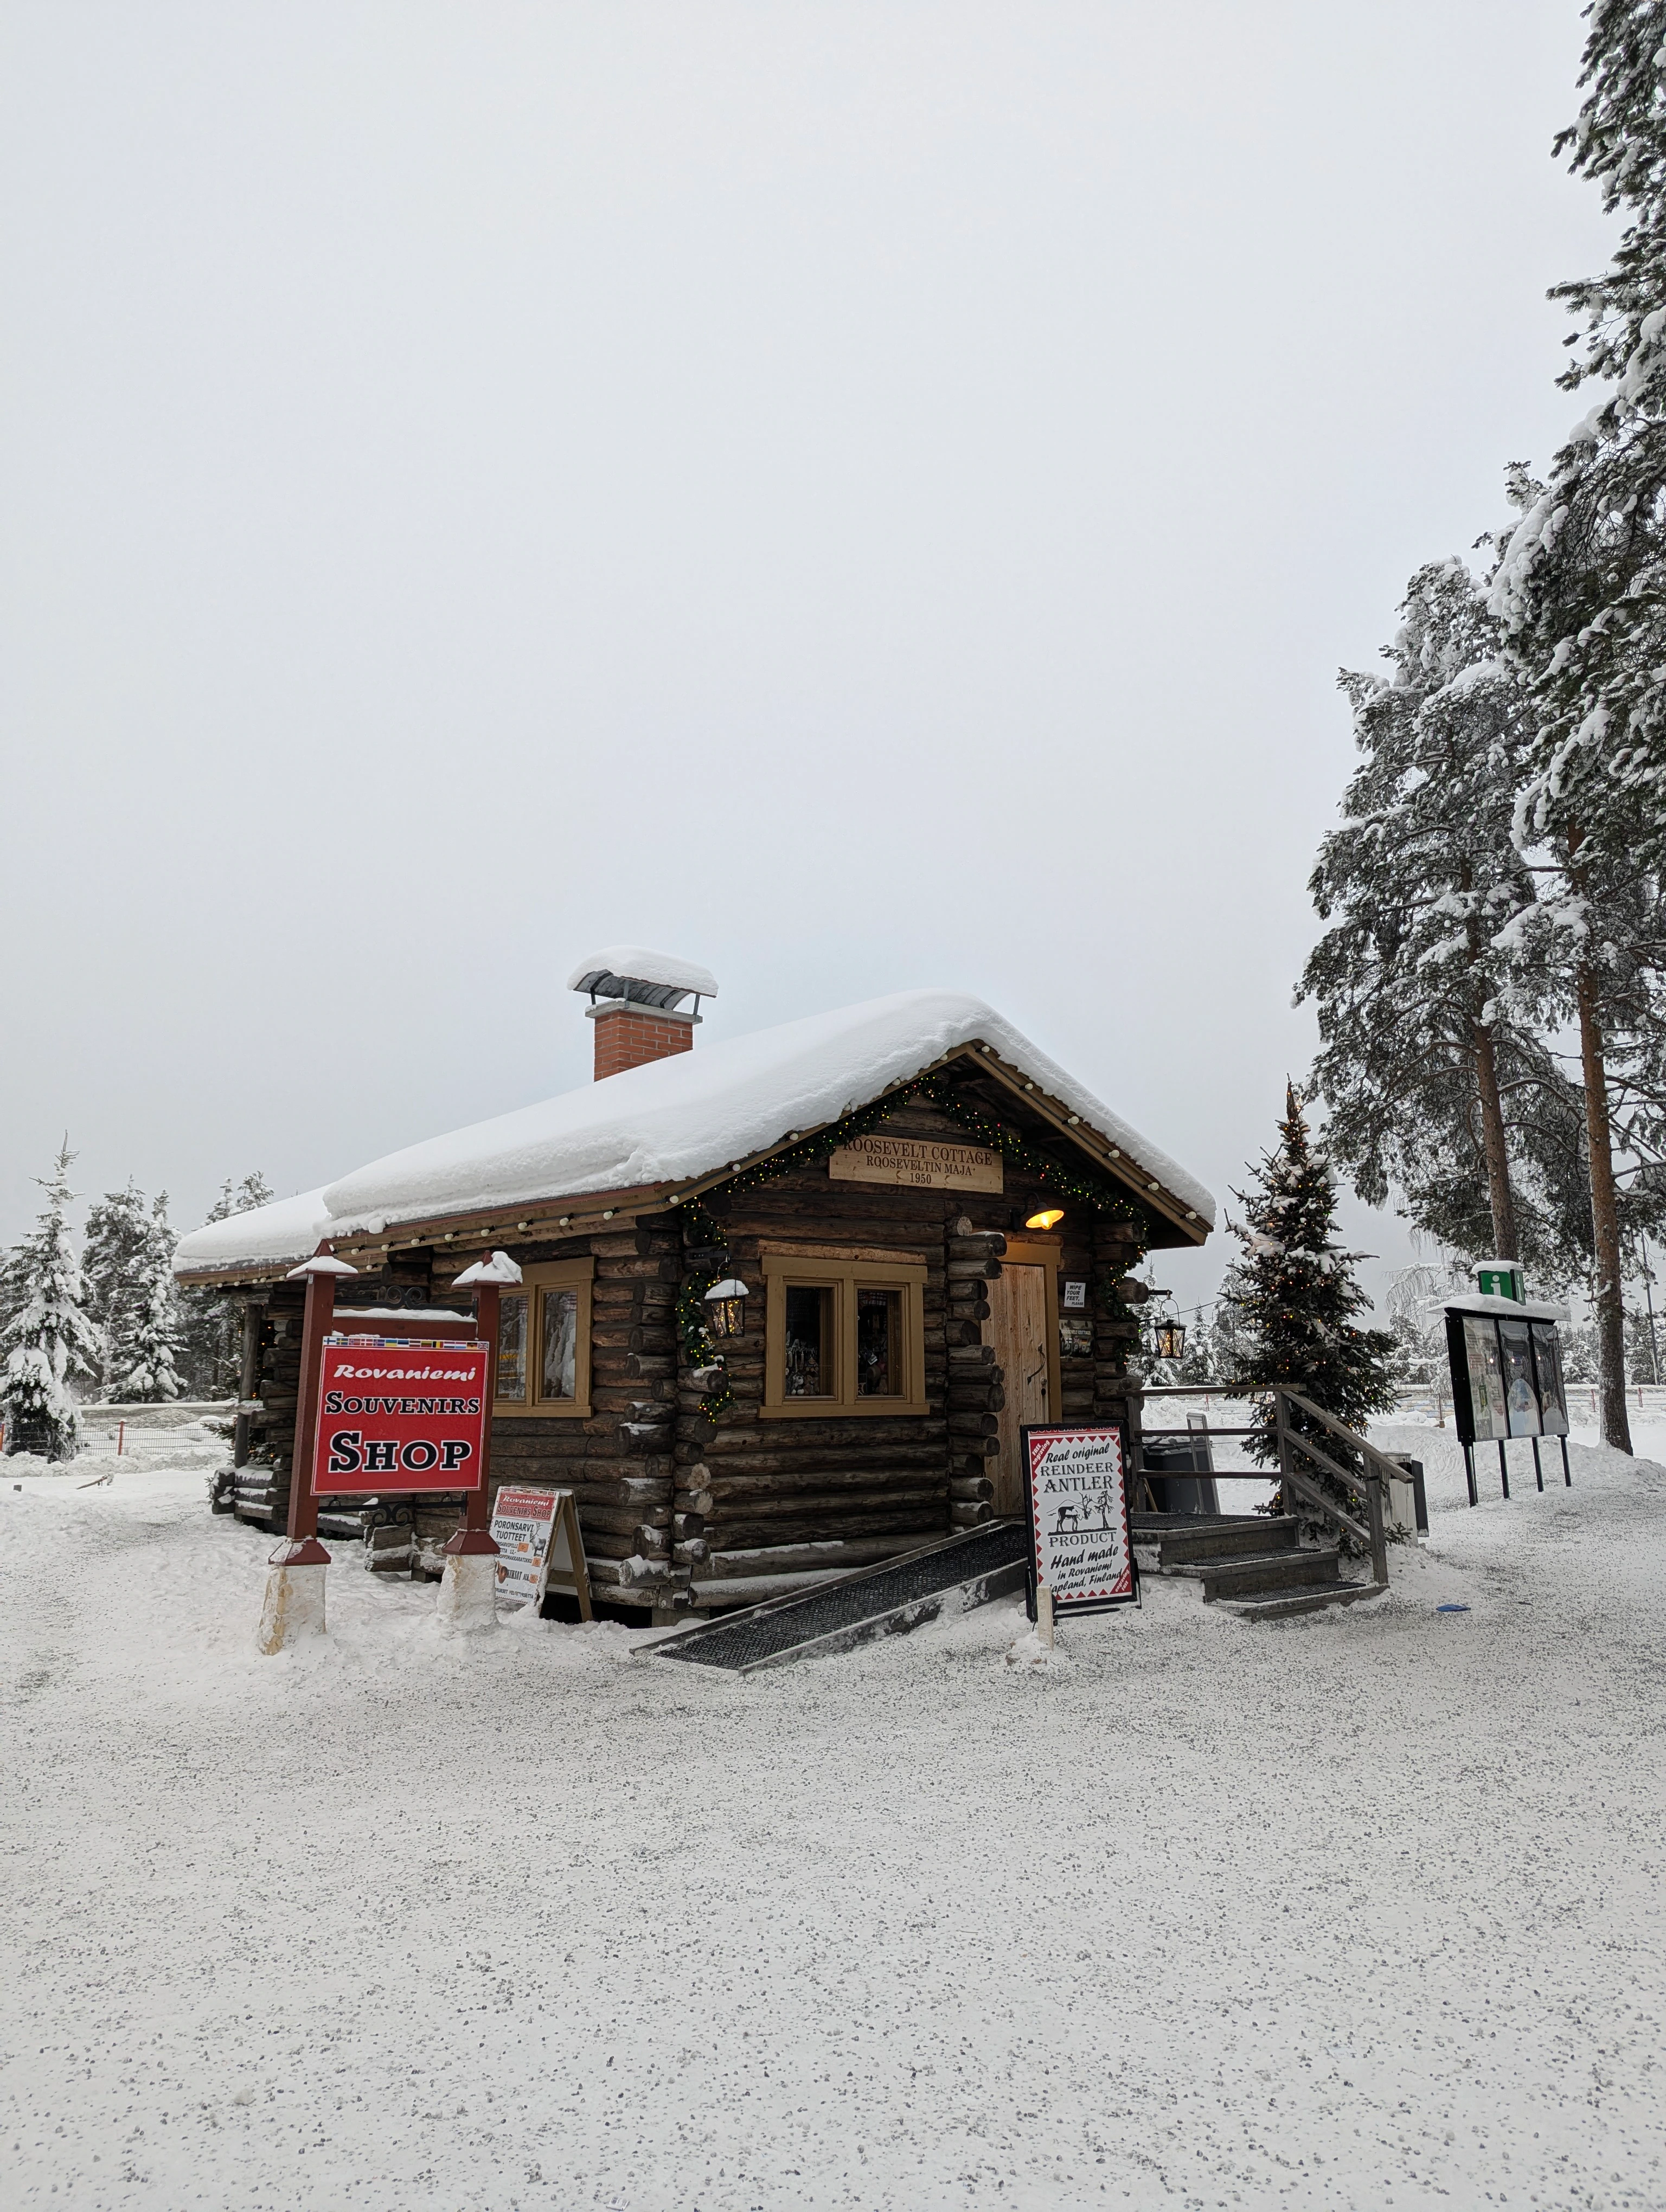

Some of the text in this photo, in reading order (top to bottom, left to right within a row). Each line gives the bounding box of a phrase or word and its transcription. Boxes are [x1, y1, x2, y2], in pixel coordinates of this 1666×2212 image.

[931, 1146, 992, 1165] COTTAGE
[866, 1155, 972, 1175] ROOSEVELTIN MAJA
[910, 1173, 931, 1184] 1950
[334, 1365, 476, 1381] Rovaniemi
[324, 1391, 480, 1415] SOUVENIRS
[328, 1430, 472, 1473] SHOP
[1032, 1443, 1041, 1456] FREE
[1032, 1439, 1050, 1465] engraving
[1046, 1443, 1110, 1464] Real original
[1040, 1462, 1114, 1476] REINDEER
[1043, 1475, 1114, 1493] ANTLER
[503, 1495, 549, 1507] Rovaniemi
[497, 1502, 551, 1518] SOUVENIRS SHOP
[494, 1520, 534, 1532] PORONSARVI
[496, 1531, 527, 1542] TUOTTEET
[1049, 1532, 1117, 1547] PRODUCT
[1050, 1544, 1119, 1570] Hand made
[1058, 1559, 1112, 1580] in Rovaniemi
[1089, 1568, 1122, 1585] Finland
[1115, 1569, 1130, 1592] engraving
